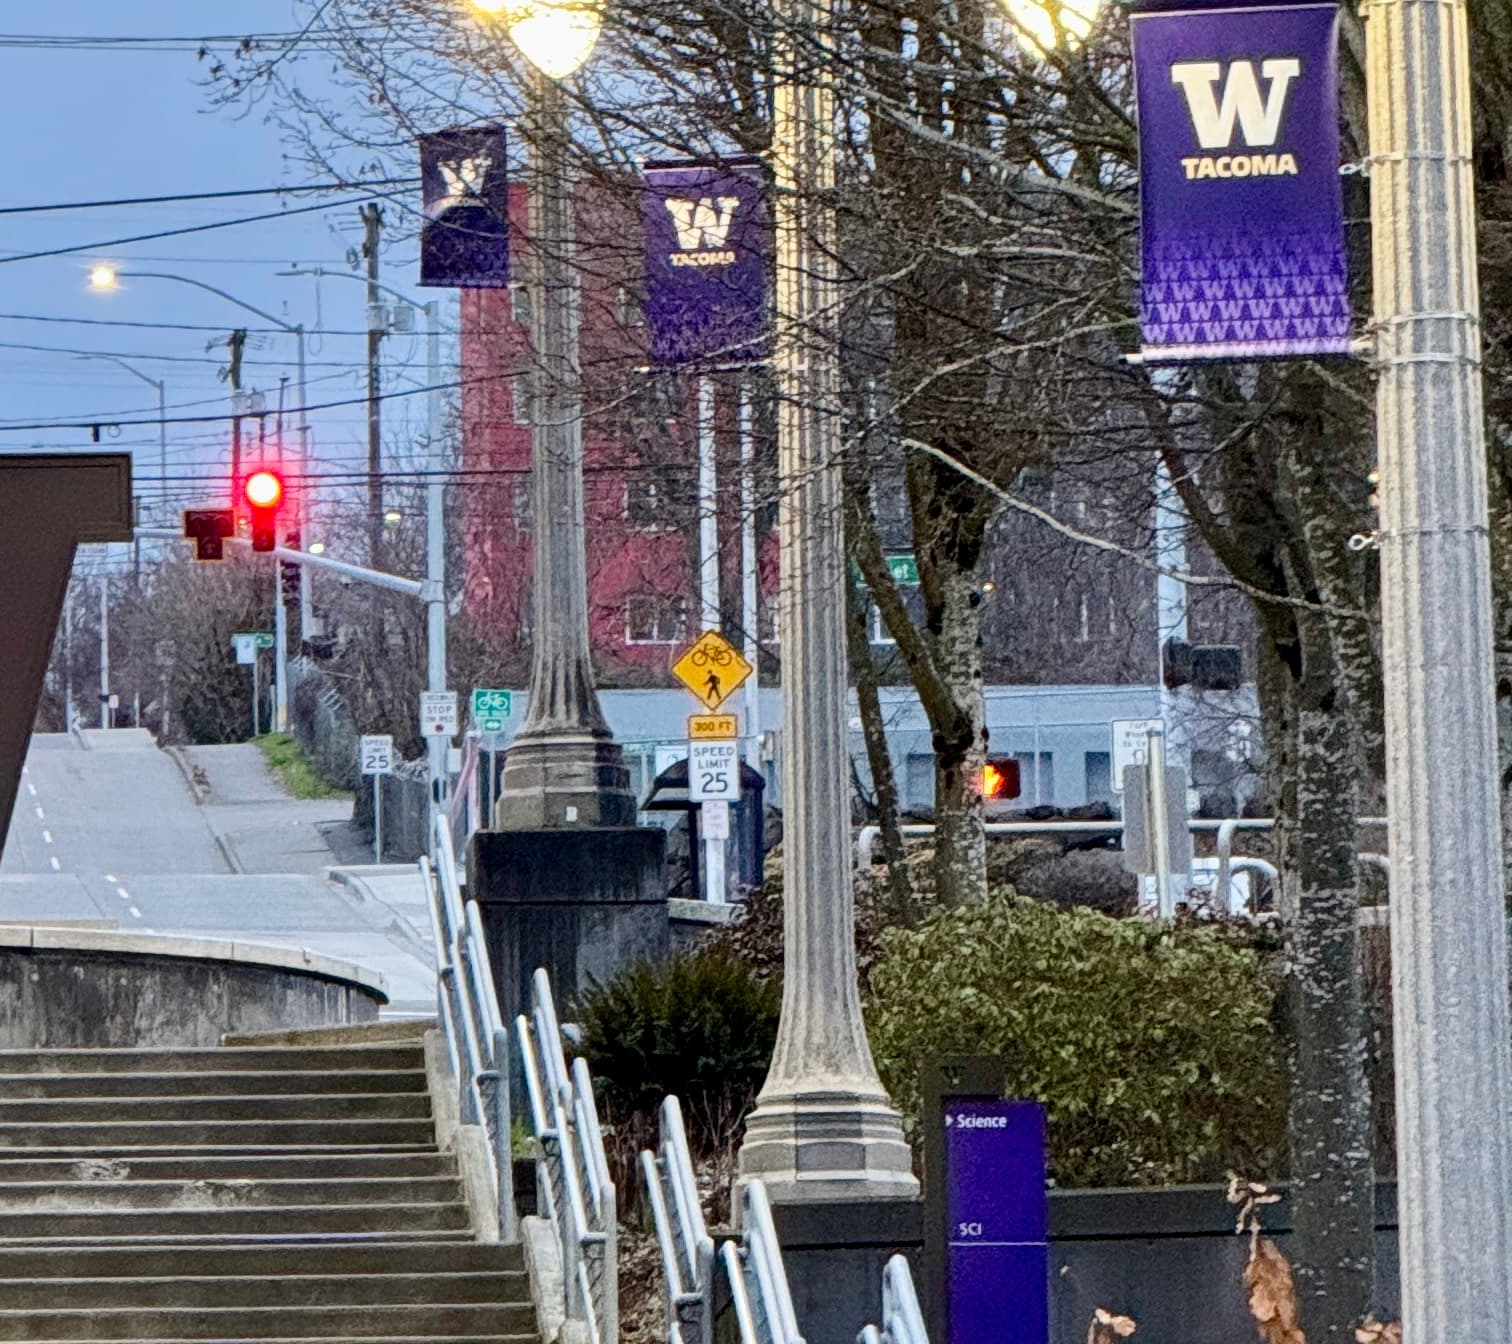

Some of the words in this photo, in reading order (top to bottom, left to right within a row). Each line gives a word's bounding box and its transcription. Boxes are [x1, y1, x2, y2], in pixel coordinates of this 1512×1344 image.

[1171, 58, 1300, 148] W
[1181, 154, 1298, 180] TACOMA
[665, 196, 740, 250] W
[427, 705, 453, 714] STOP
[694, 722, 715, 732] 300
[718, 721, 733, 732] FT
[693, 746, 735, 757] SPEED
[366, 755, 390, 769] 25
[697, 758, 730, 769] LIMIT
[701, 772, 728, 793] 25
[956, 1114, 1008, 1129] Science
[959, 1222, 982, 1236] SCI
